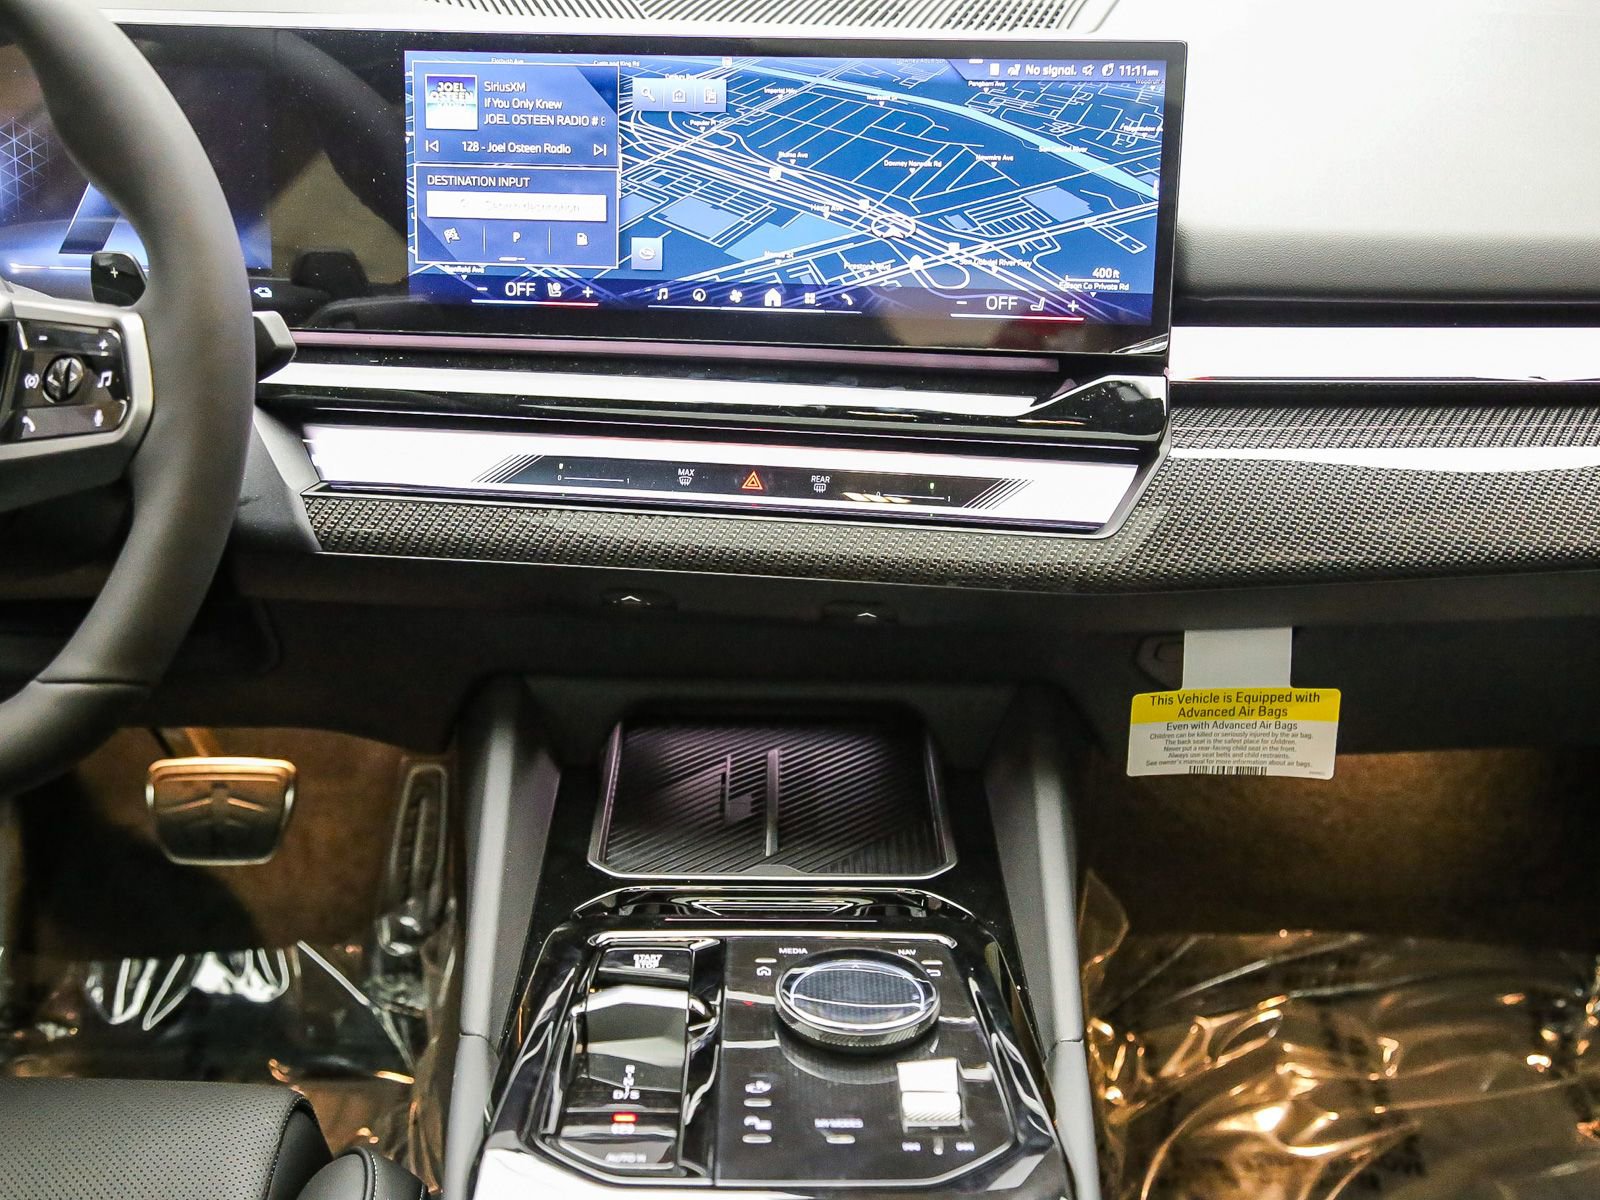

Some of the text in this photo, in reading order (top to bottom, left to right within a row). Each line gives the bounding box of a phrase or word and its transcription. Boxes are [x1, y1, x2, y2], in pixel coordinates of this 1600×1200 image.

[1025, 64, 1077, 78] No signal.
[437, 81, 467, 92] JOEL
[484, 81, 526, 92] SiriusXM
[484, 98, 562, 111] If You Only Knew
[484, 114, 509, 125] JOEL
[512, 115, 555, 126] OSTEEN
[557, 116, 589, 126] RADIO
[462, 141, 479, 152] 128
[487, 141, 505, 153] Joel
[508, 142, 541, 153] Osteen
[544, 143, 571, 154] Radio
[427, 175, 530, 188] DESTINATION INPUT
[505, 282, 535, 296] OFF
[1083, 282, 1092, 290] Co
[1119, 283, 1129, 291] Rd
[986, 295, 1018, 310] OFF
[677, 468, 695, 477] MAX
[811, 475, 830, 483] REAR
[1150, 691, 1320, 706] This Vehicle is Equipped with
[1178, 705, 1288, 719] Advanced Air Bags
[1166, 720, 1298, 732] Even with Advanced Air Bags
[778, 947, 808, 955] MEDIA
[897, 948, 917, 956] NAV
